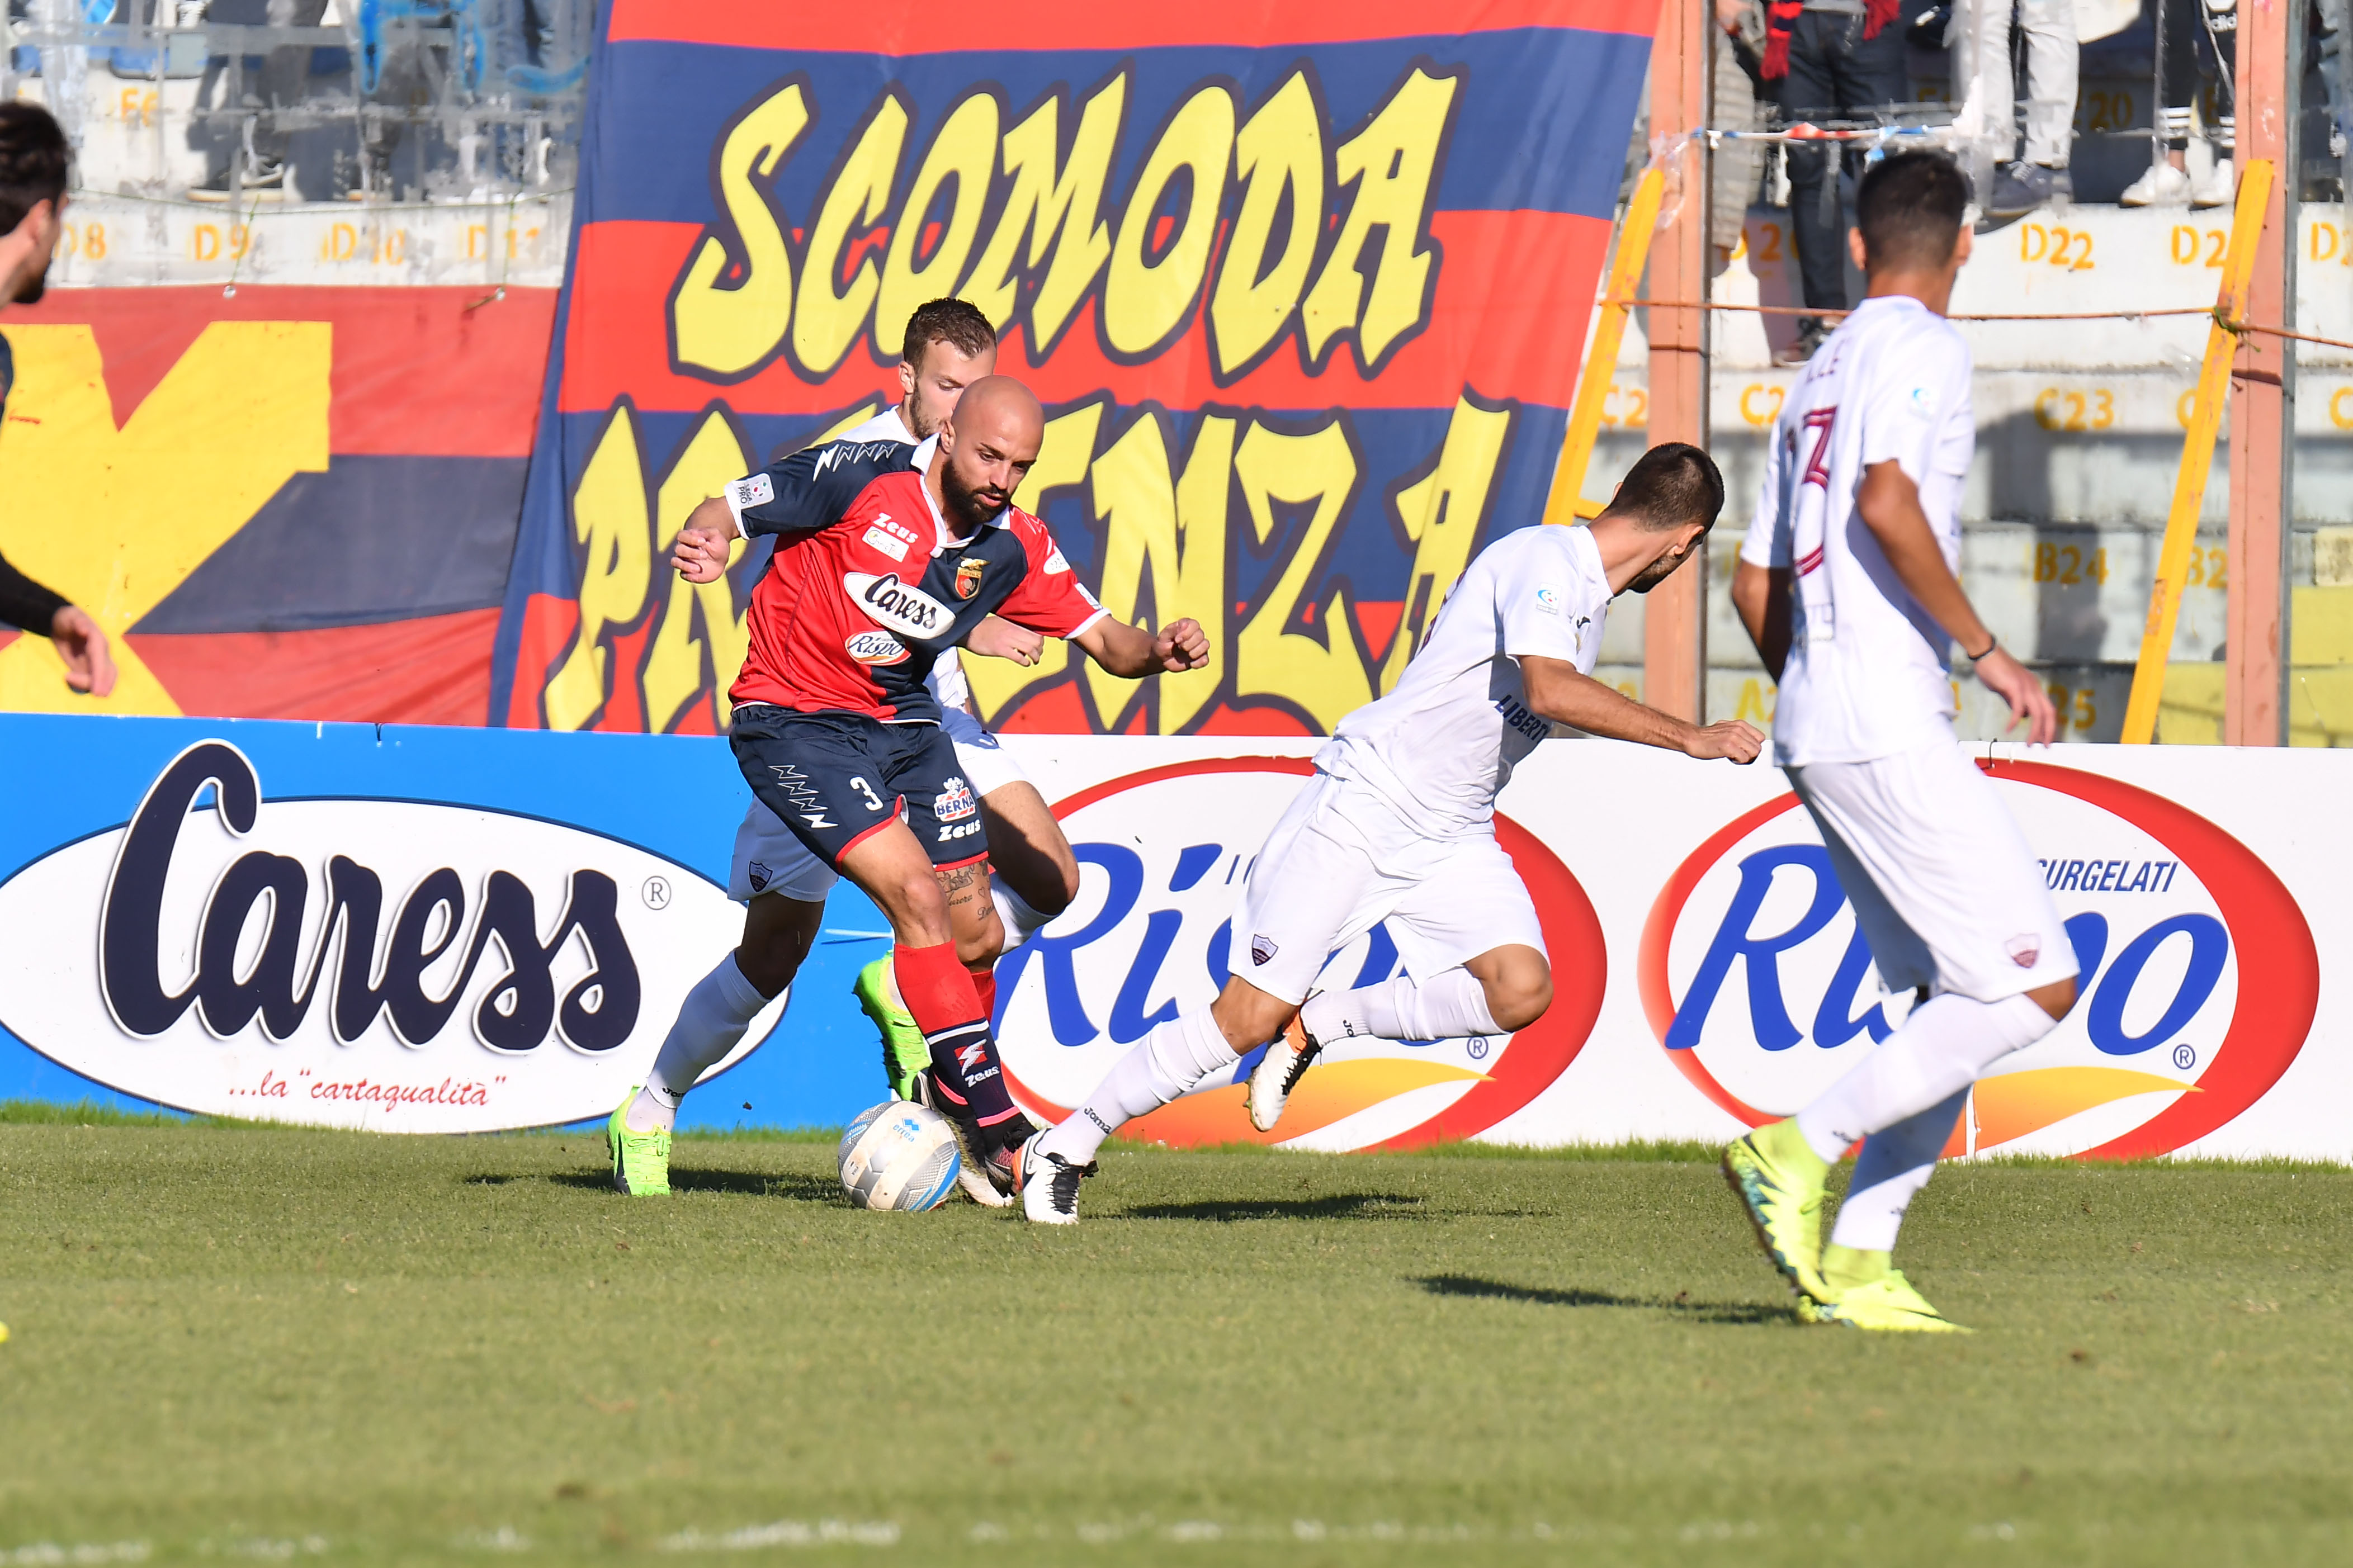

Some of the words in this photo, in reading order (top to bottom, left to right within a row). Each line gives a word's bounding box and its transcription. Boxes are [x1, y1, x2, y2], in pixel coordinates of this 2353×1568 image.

[674, 67, 1457, 375] SCOMODA
[2020, 223, 2095, 270] D22
[2171, 225, 2227, 268] D2
[1739, 382, 1786, 426] C2
[2034, 387, 2115, 432] C23
[738, 486, 748, 504] PRO
[872, 511, 919, 544] Zeus
[2034, 542, 2109, 586] B24
[864, 574, 937, 629] Caress
[847, 635, 906, 657] Rispo
[850, 776, 884, 811] 3
[936, 795, 975, 816] BERNA
[938, 819, 981, 842] Zeus
[100, 739, 642, 1054] Caress
[965, 1065, 1000, 1088] Zeus
[1084, 1107, 1112, 1134] Joma
